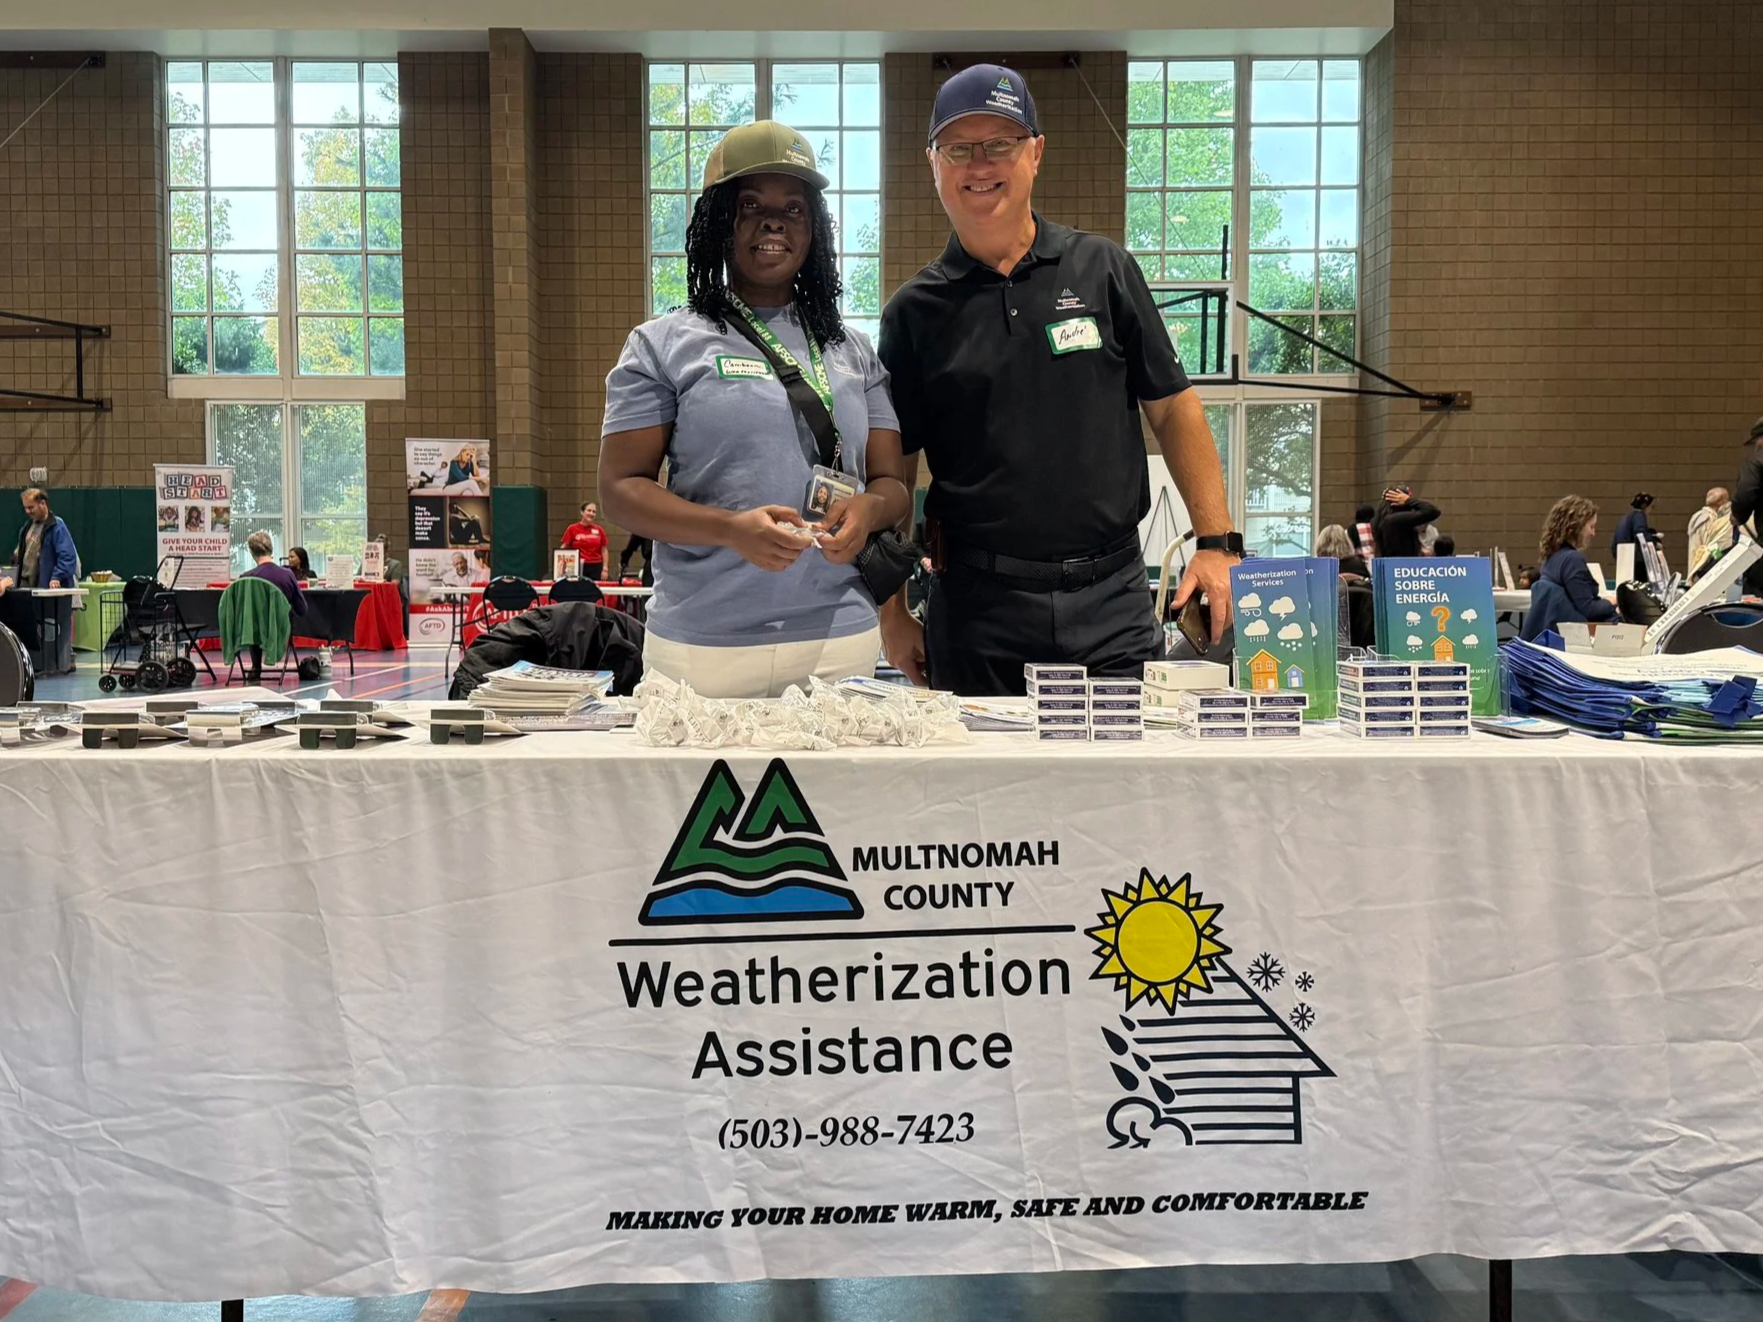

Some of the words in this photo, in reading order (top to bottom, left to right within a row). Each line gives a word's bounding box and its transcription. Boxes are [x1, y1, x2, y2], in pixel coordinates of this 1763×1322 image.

[995, 96, 1015, 106] County
[168, 475, 220, 487] HEAD
[164, 487, 227, 499] START
[1237, 569, 1297, 580] Weatherization
[1394, 565, 1467, 578] EDUCACIÓN
[1251, 579, 1284, 588] Services
[1395, 580, 1436, 591] SOBRE
[1396, 591, 1450, 604] ENERGÍA
[853, 841, 1059, 872] MULTNOMAH
[884, 882, 1015, 911] COUNTY
[617, 948, 1070, 1008] Weatherization
[692, 1027, 1013, 1079] Assistance
[718, 1113, 975, 1150] (503)-988-7423
[606, 1210, 725, 1231] MAKING
[732, 1207, 808, 1229] YOUR
[812, 1205, 899, 1226] HOME
[906, 1200, 1003, 1224] WARM,
[1011, 1199, 1079, 1218] SAFE
[1083, 1197, 1146, 1217] AND
[1152, 1192, 1370, 1214] COMFORTABLE
